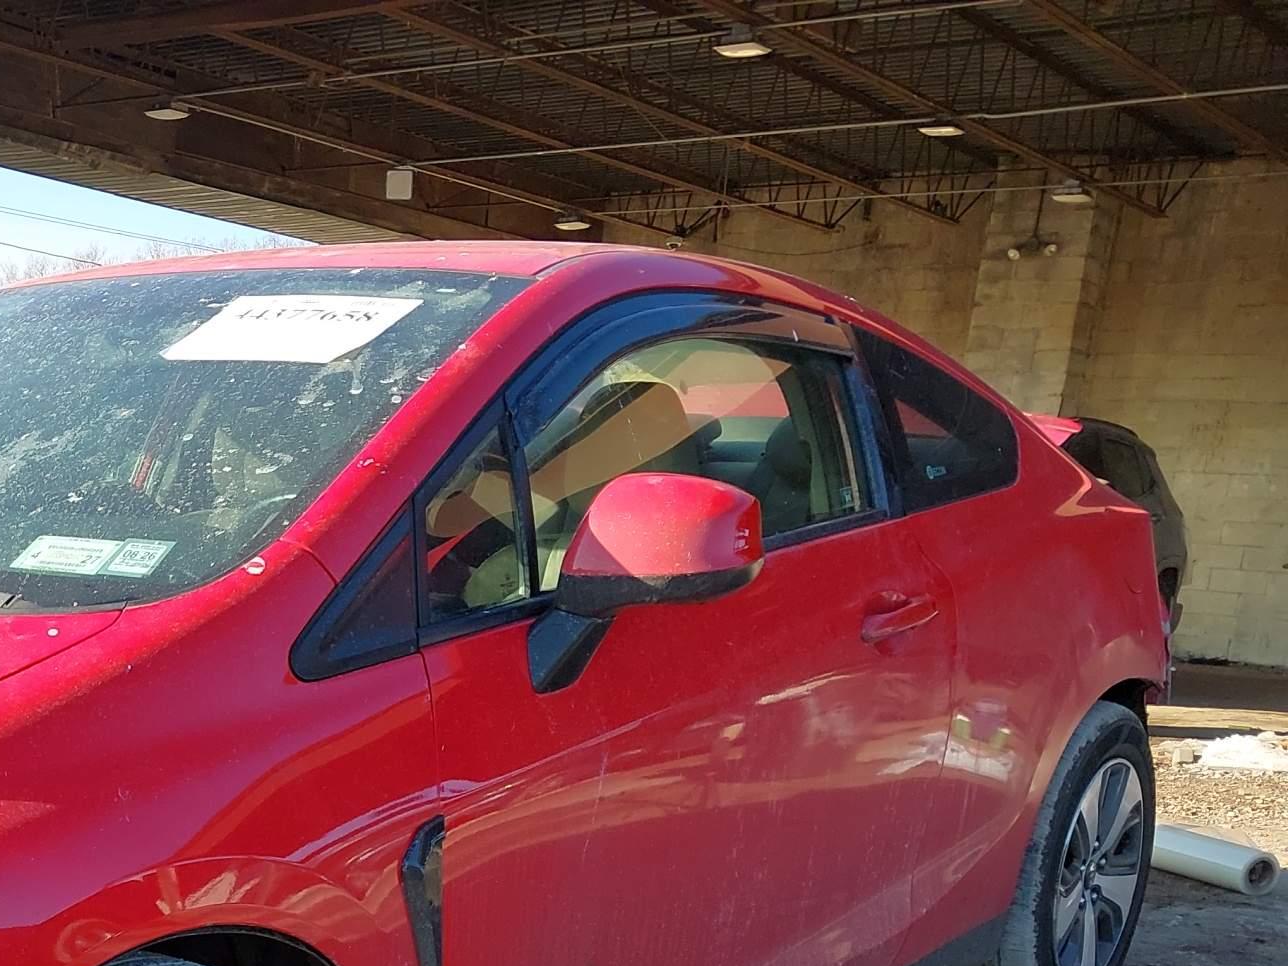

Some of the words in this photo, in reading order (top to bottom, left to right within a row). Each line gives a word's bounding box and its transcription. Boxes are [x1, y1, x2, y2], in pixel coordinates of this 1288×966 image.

[80, 554, 101, 565] 27
[123, 549, 139, 559] 08
[140, 551, 158, 560] 26
